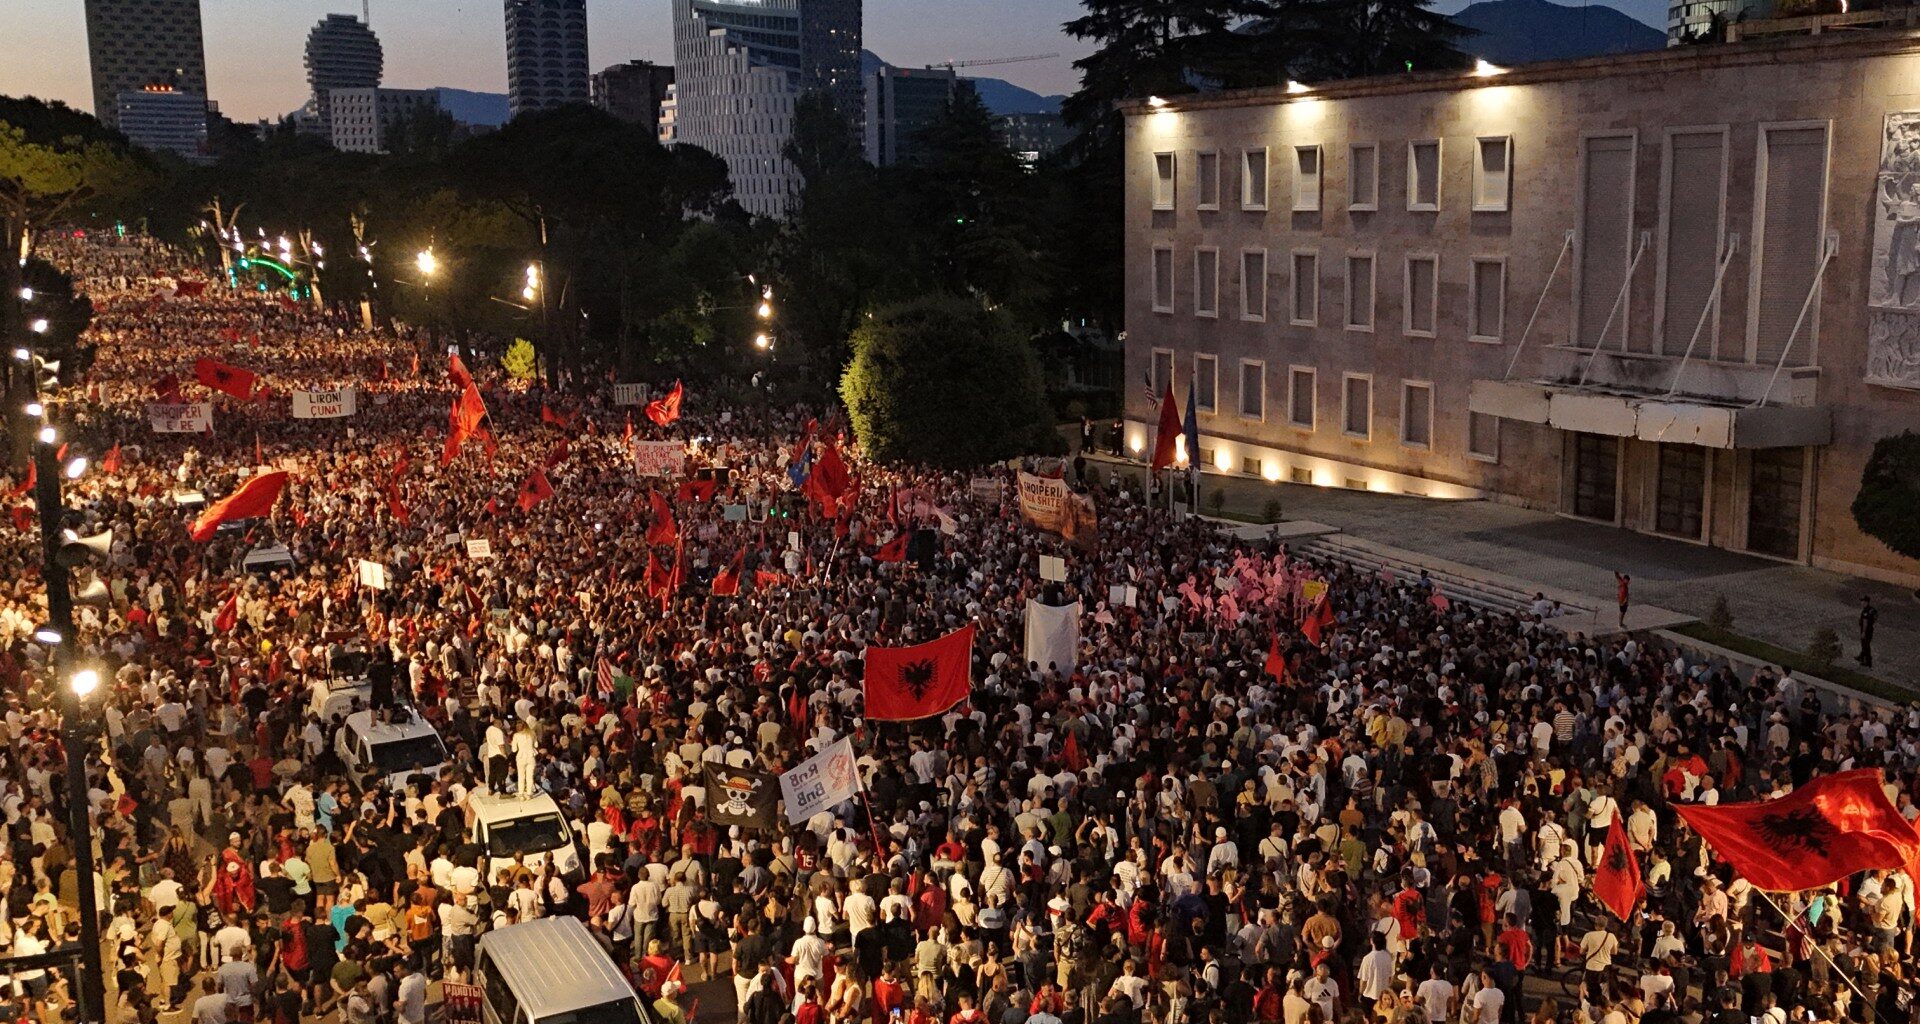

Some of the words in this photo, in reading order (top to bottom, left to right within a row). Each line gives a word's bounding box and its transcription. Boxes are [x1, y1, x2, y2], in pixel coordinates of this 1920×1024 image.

[309, 393, 342, 404] LIRONI
[311, 404, 342, 417] ÇUNAT
[166, 421, 174, 431] E
[180, 421, 195, 431] RE
[802, 854, 814, 868] 15
